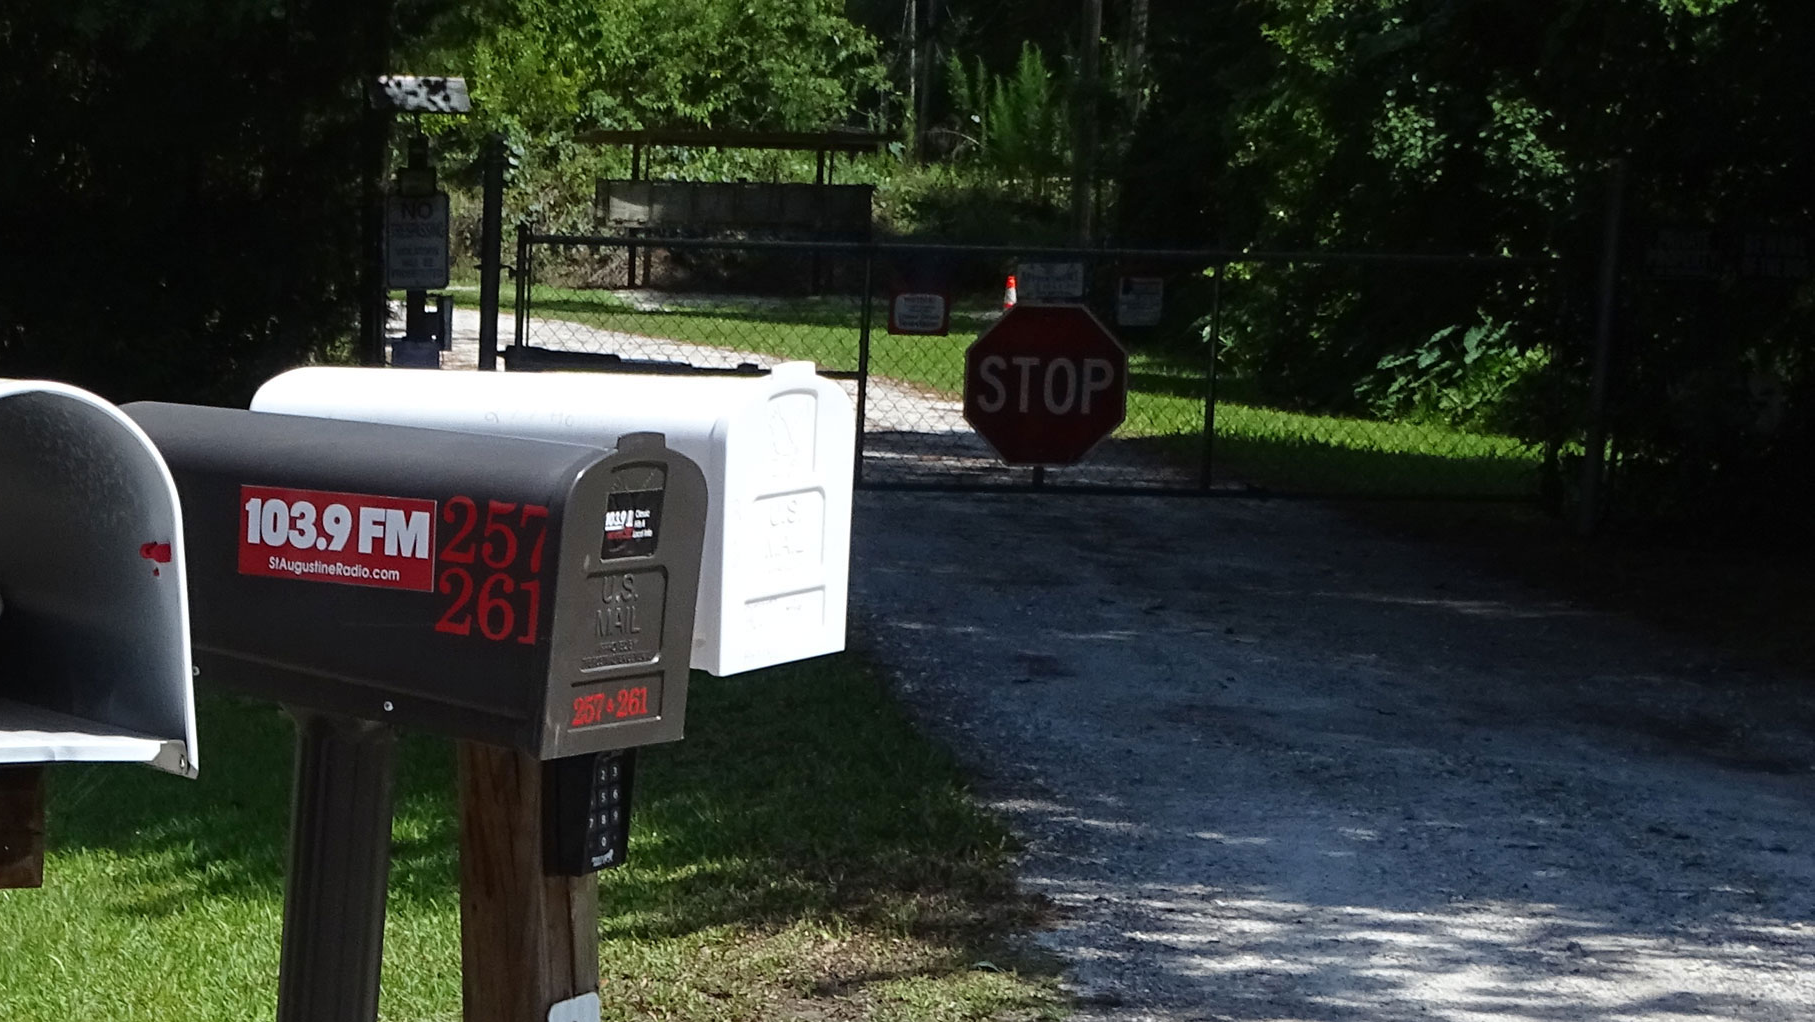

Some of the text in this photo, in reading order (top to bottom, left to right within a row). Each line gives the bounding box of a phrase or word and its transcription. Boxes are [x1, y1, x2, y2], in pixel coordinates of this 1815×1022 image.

[401, 201, 433, 219] NO
[977, 355, 1115, 415] STOP
[245, 497, 430, 560] 103.9 FM
[439, 495, 549, 574] 257
[268, 555, 400, 582] StAugustineRadio.com
[434, 568, 540, 645] 261
[572, 693, 604, 726] 257
[616, 687, 648, 718] 261
